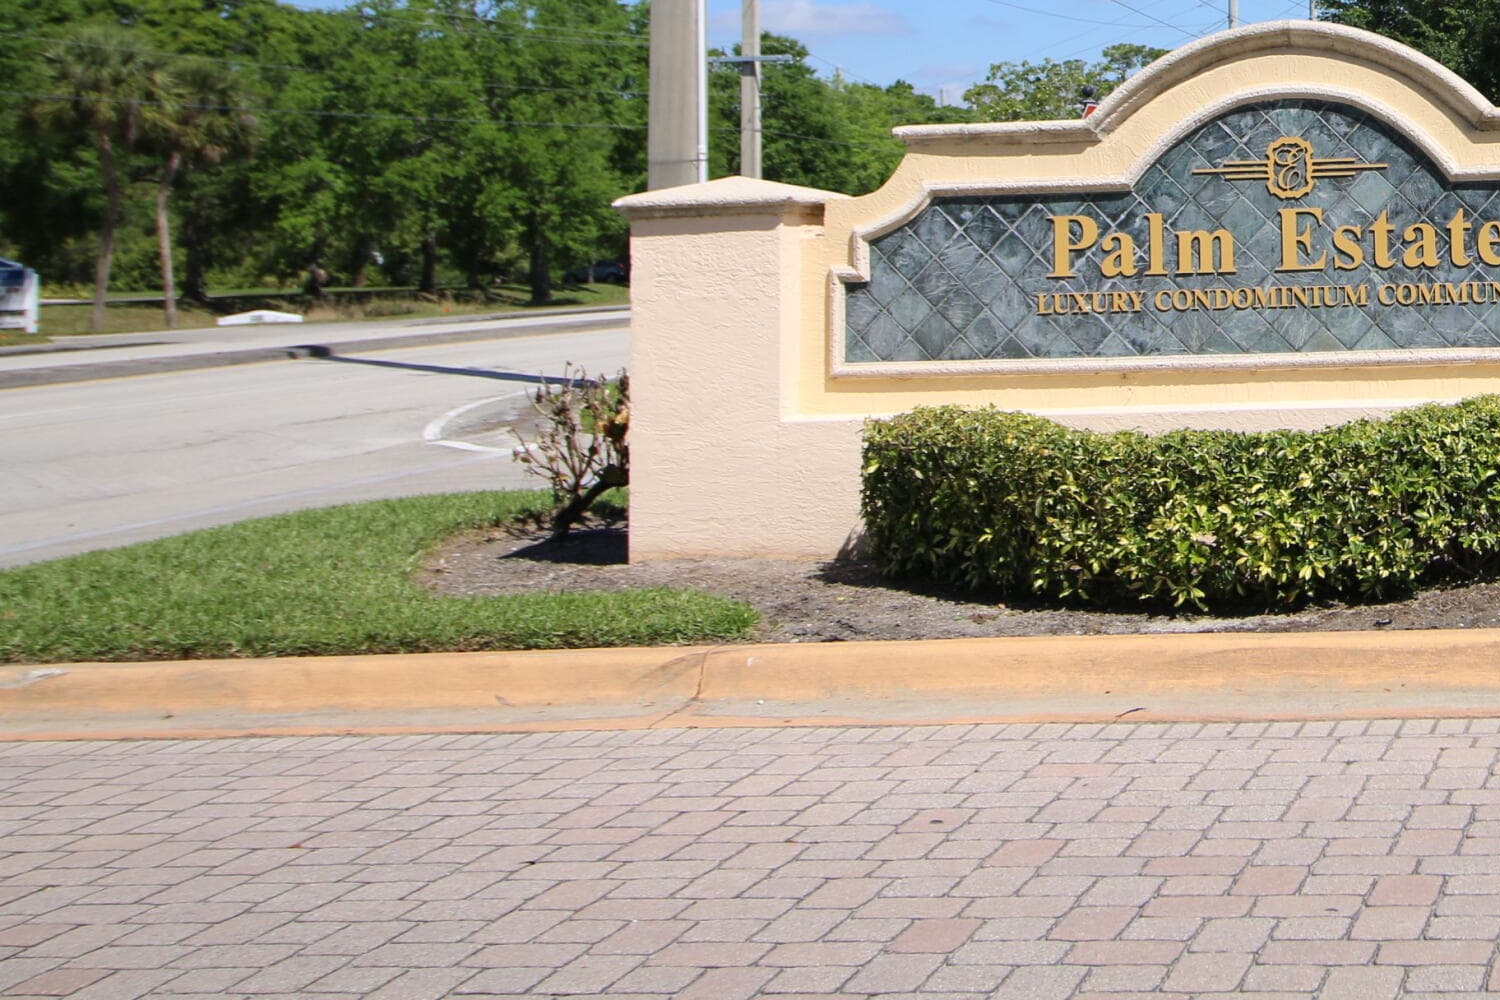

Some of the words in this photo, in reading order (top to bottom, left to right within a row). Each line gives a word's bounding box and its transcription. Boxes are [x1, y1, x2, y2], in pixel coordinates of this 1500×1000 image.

[1046, 213, 1237, 278] Palm
[1036, 290, 1146, 315] LUXURY
[1154, 284, 1369, 313] CONDOMINIUM
